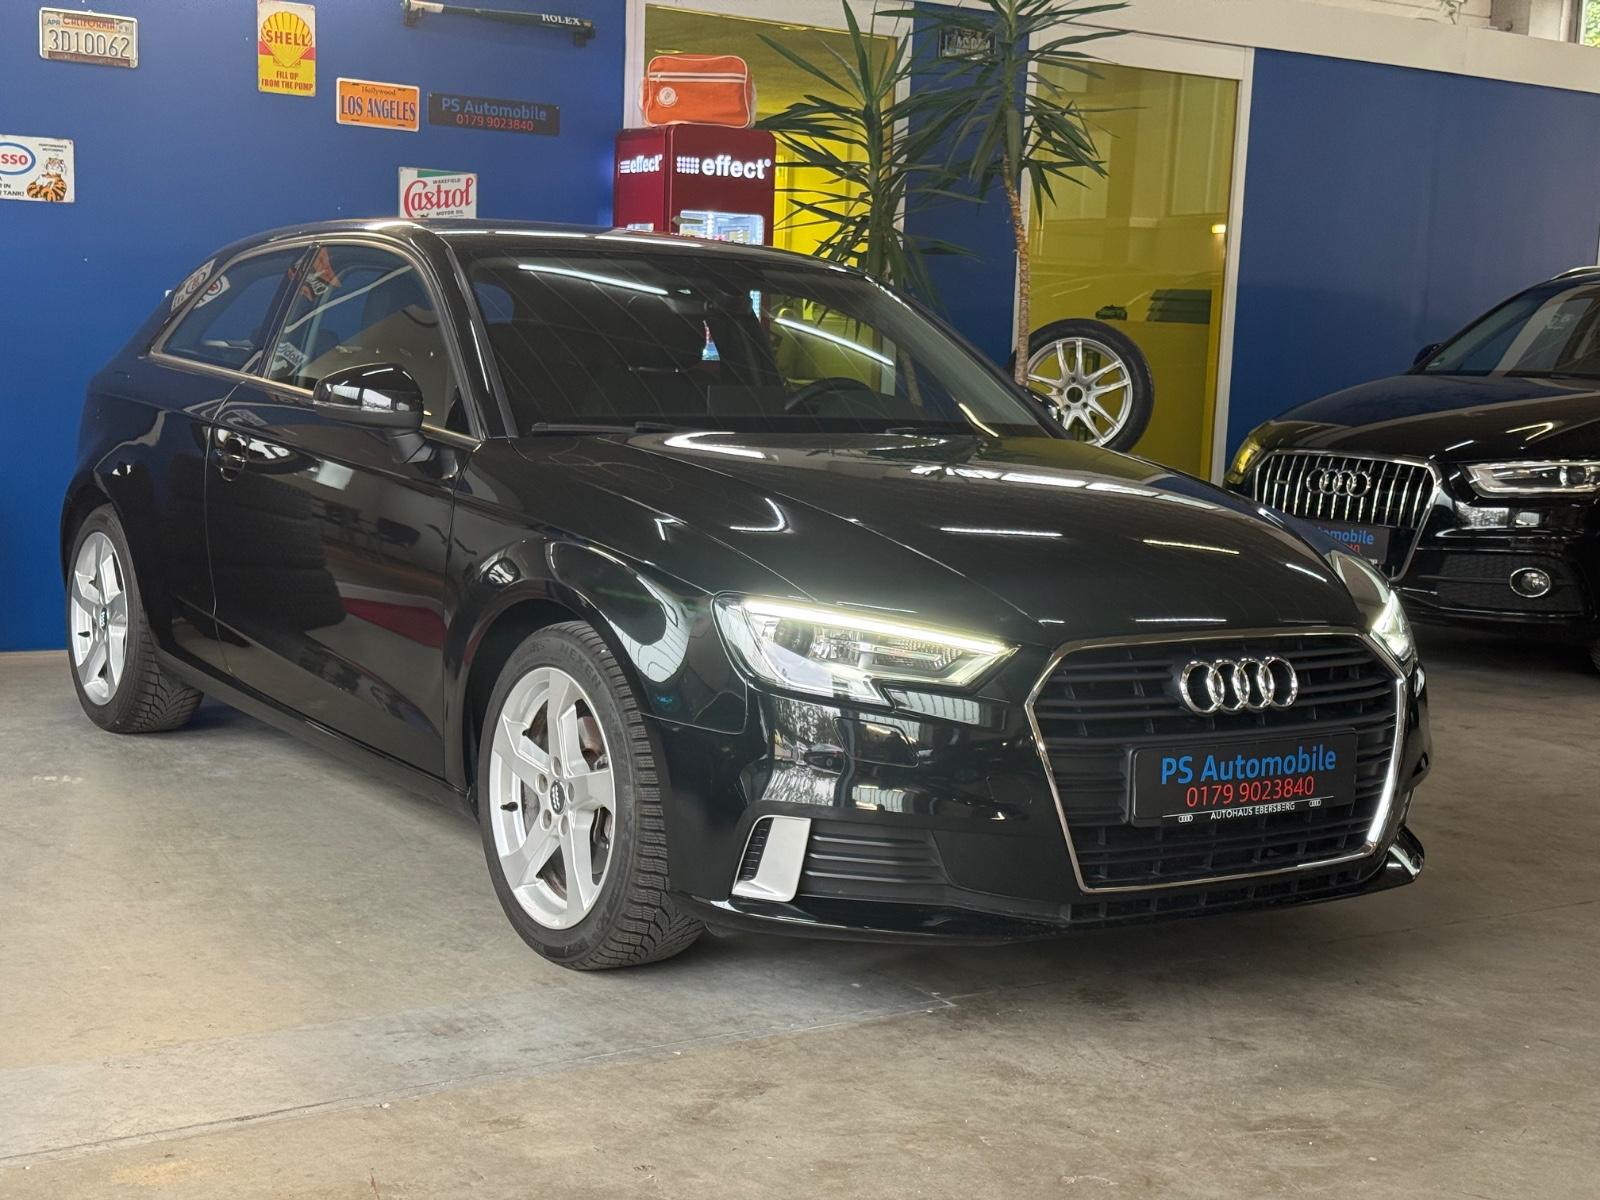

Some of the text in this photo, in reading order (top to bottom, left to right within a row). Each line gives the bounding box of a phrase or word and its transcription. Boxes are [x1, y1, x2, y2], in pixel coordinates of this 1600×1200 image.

[541, 13, 581, 26] ROLEX
[49, 28, 130, 58] 3D10062
[266, 29, 308, 47] SHELL
[261, 78, 314, 91] FROM THE PUMP
[276, 70, 299, 81] FILL UP
[361, 86, 396, 96] Hollywood
[341, 94, 416, 122] LOS ANGELES
[441, 97, 547, 121] PS Automobile
[456, 113, 534, 132] 0179 9023840
[0, 153, 29, 166] SSO
[630, 153, 661, 174] effect
[701, 153, 767, 180] effect
[403, 176, 474, 218] Castrol
[1318, 526, 1375, 545] mobile
[1161, 743, 1337, 785] PS Automobile
[1186, 775, 1315, 808] 0179 9023840
[1210, 801, 1296, 821] AUTOHAUS EBERSBERG
